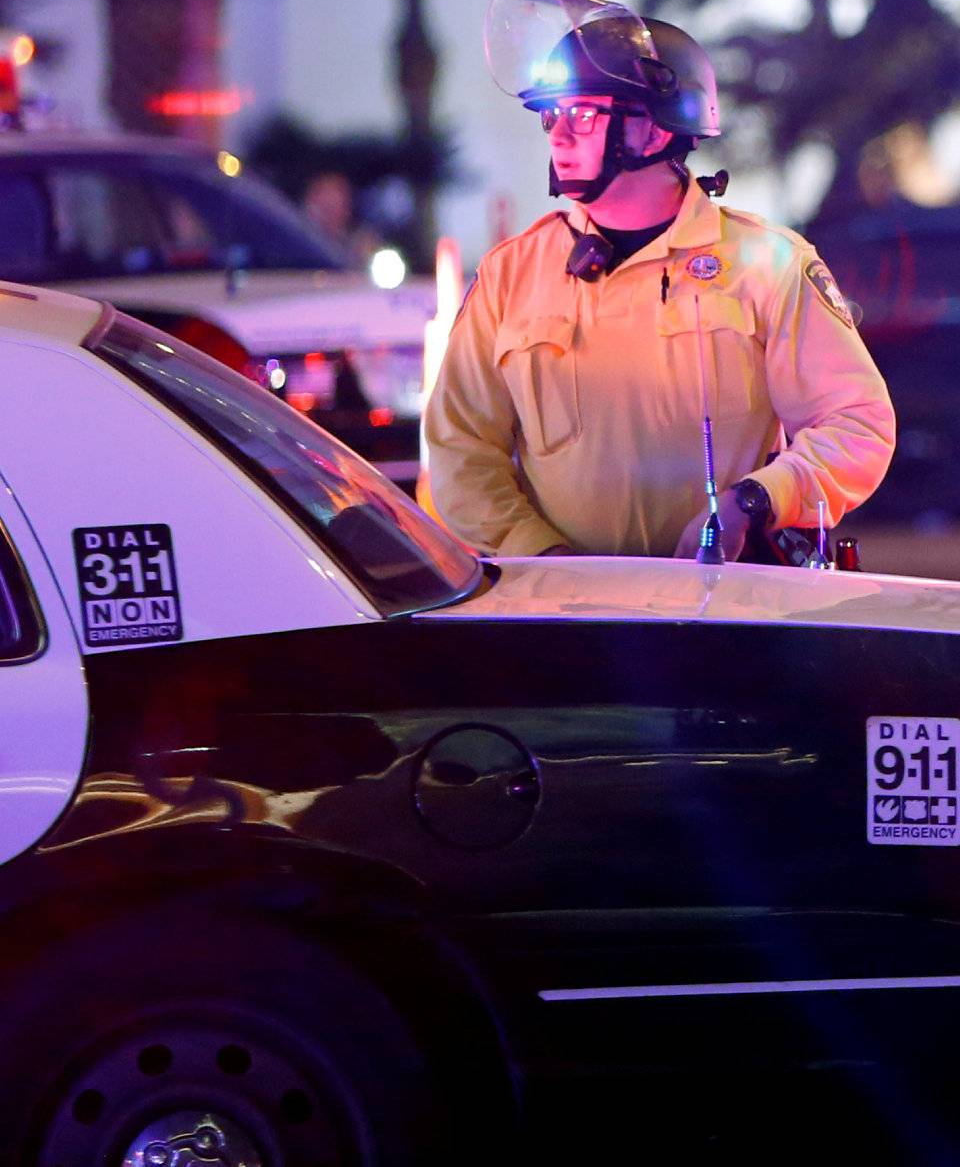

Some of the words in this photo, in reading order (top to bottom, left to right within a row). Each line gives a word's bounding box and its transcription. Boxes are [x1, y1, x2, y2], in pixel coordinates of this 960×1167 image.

[84, 530, 160, 549] DIAL
[92, 600, 171, 624] NON
[89, 625, 177, 641] EMERGENCY
[879, 723, 949, 741] DIAL
[872, 826, 957, 839] EMERGENCY
